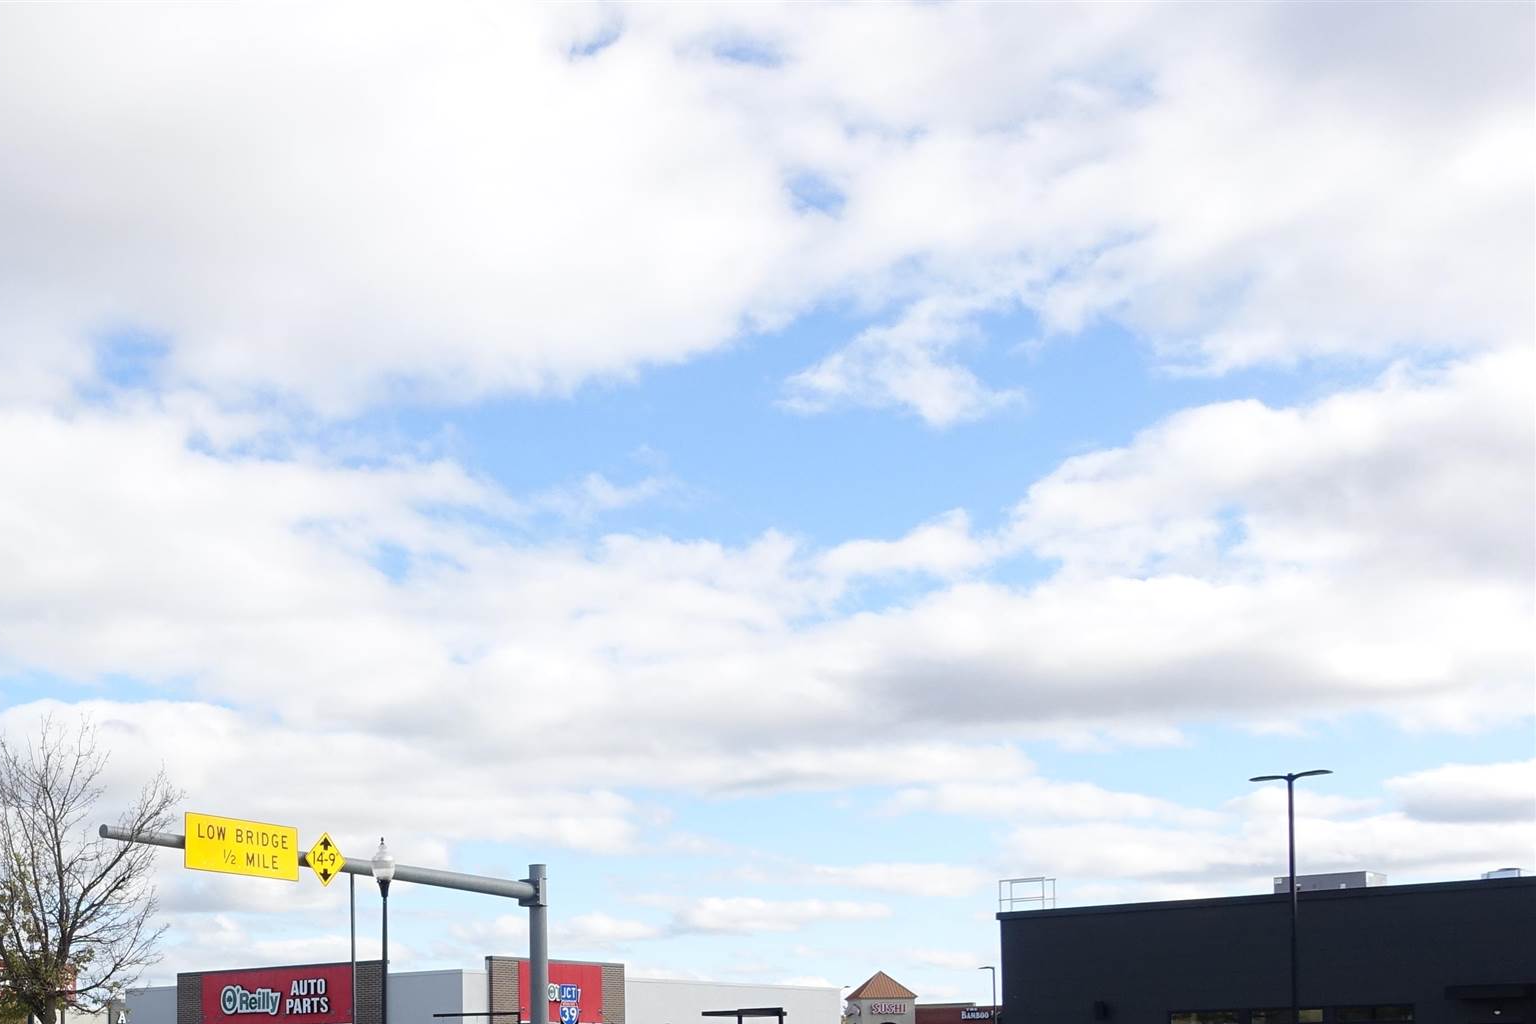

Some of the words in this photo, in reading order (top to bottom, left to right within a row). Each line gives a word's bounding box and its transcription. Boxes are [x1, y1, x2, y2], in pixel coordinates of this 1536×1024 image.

[197, 823, 227, 841] LOW
[235, 828, 289, 850] BRIDGE
[246, 852, 279, 870] MILE
[290, 978, 327, 996] AUTO
[560, 987, 577, 999] JCT
[221, 985, 281, 1016] O'Reilly
[285, 997, 330, 1015] PARTS
[872, 1002, 906, 1015] SUSHI
[561, 1007, 577, 1022] 39
